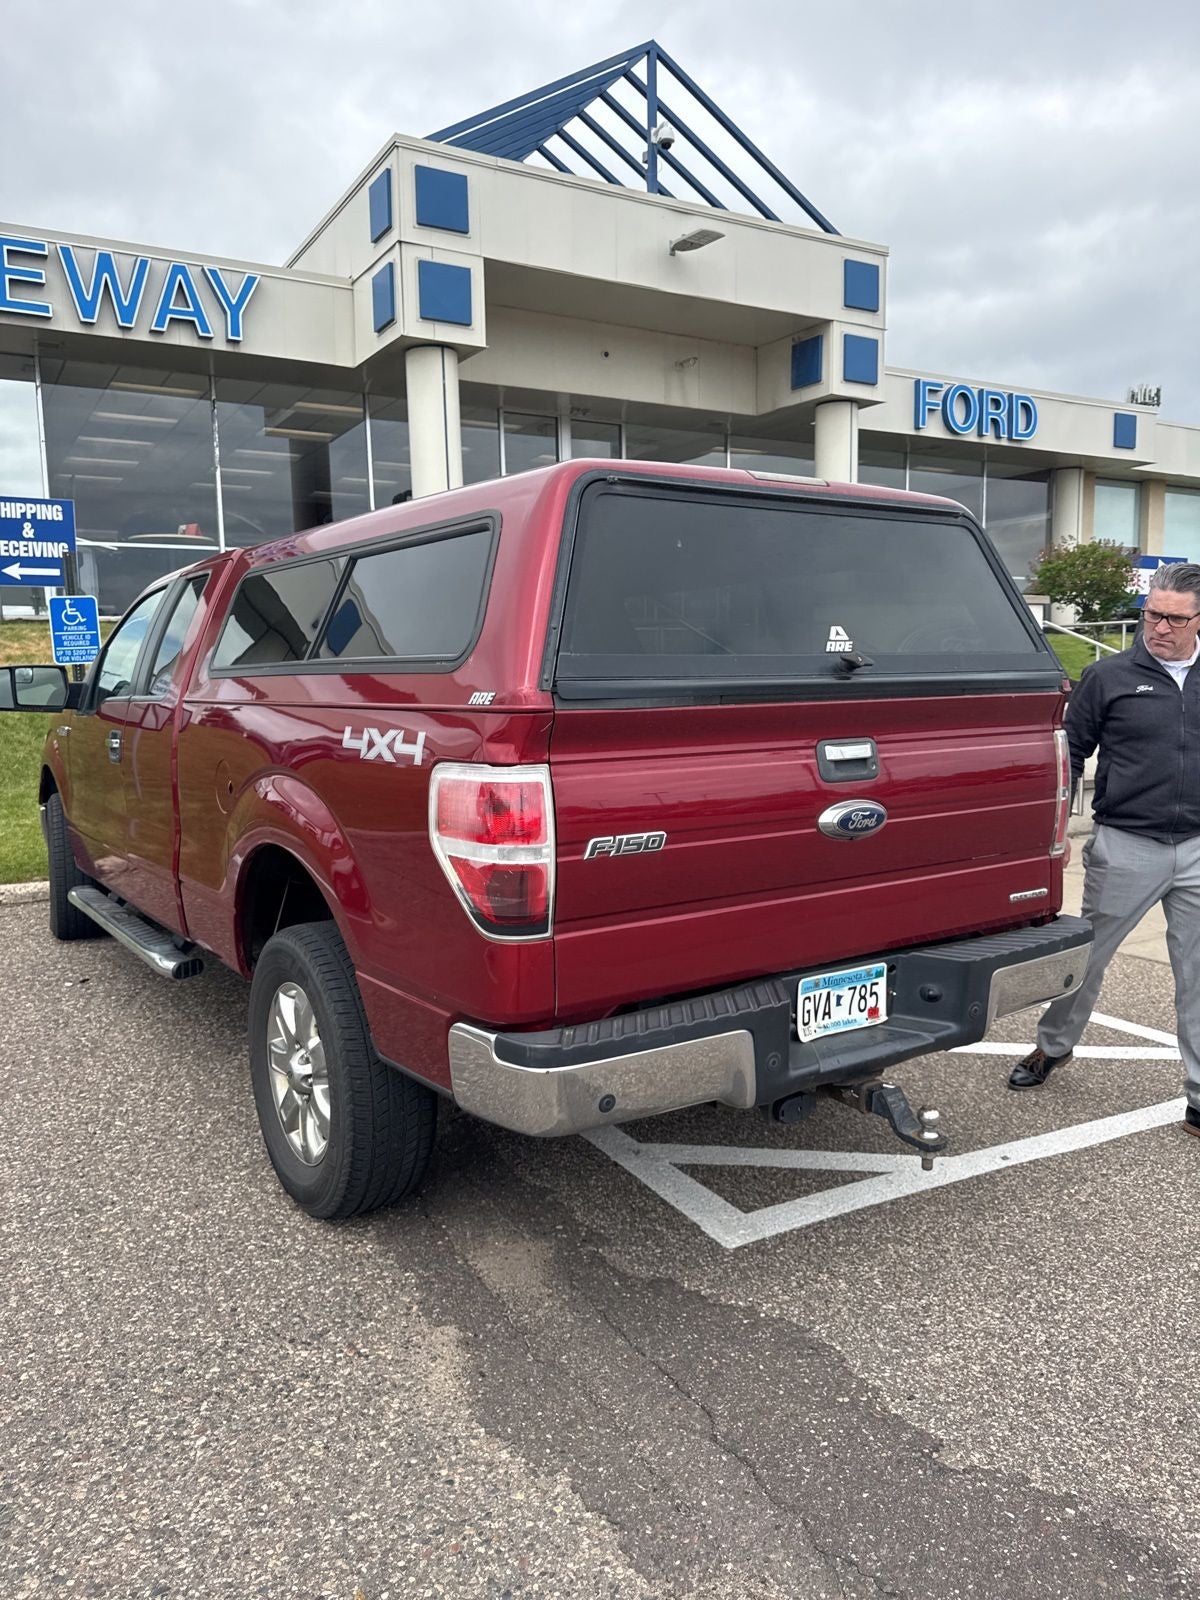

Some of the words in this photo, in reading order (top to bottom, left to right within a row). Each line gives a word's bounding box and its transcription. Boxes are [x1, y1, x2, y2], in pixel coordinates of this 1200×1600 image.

[0, 235, 261, 343] EWAY
[914, 378, 1038, 441] FORD
[0, 502, 63, 521] HIPPING
[22, 522, 34, 539] &
[0, 540, 69, 559] ECEIVING
[824, 641, 853, 652] ARE
[468, 691, 496, 705] ARE
[342, 725, 427, 766] 4X4
[848, 811, 878, 830] Ford
[583, 831, 667, 860] F-150
[822, 973, 863, 987] Minnesota
[802, 991, 831, 1026] GVA
[848, 982, 879, 1015] 785
